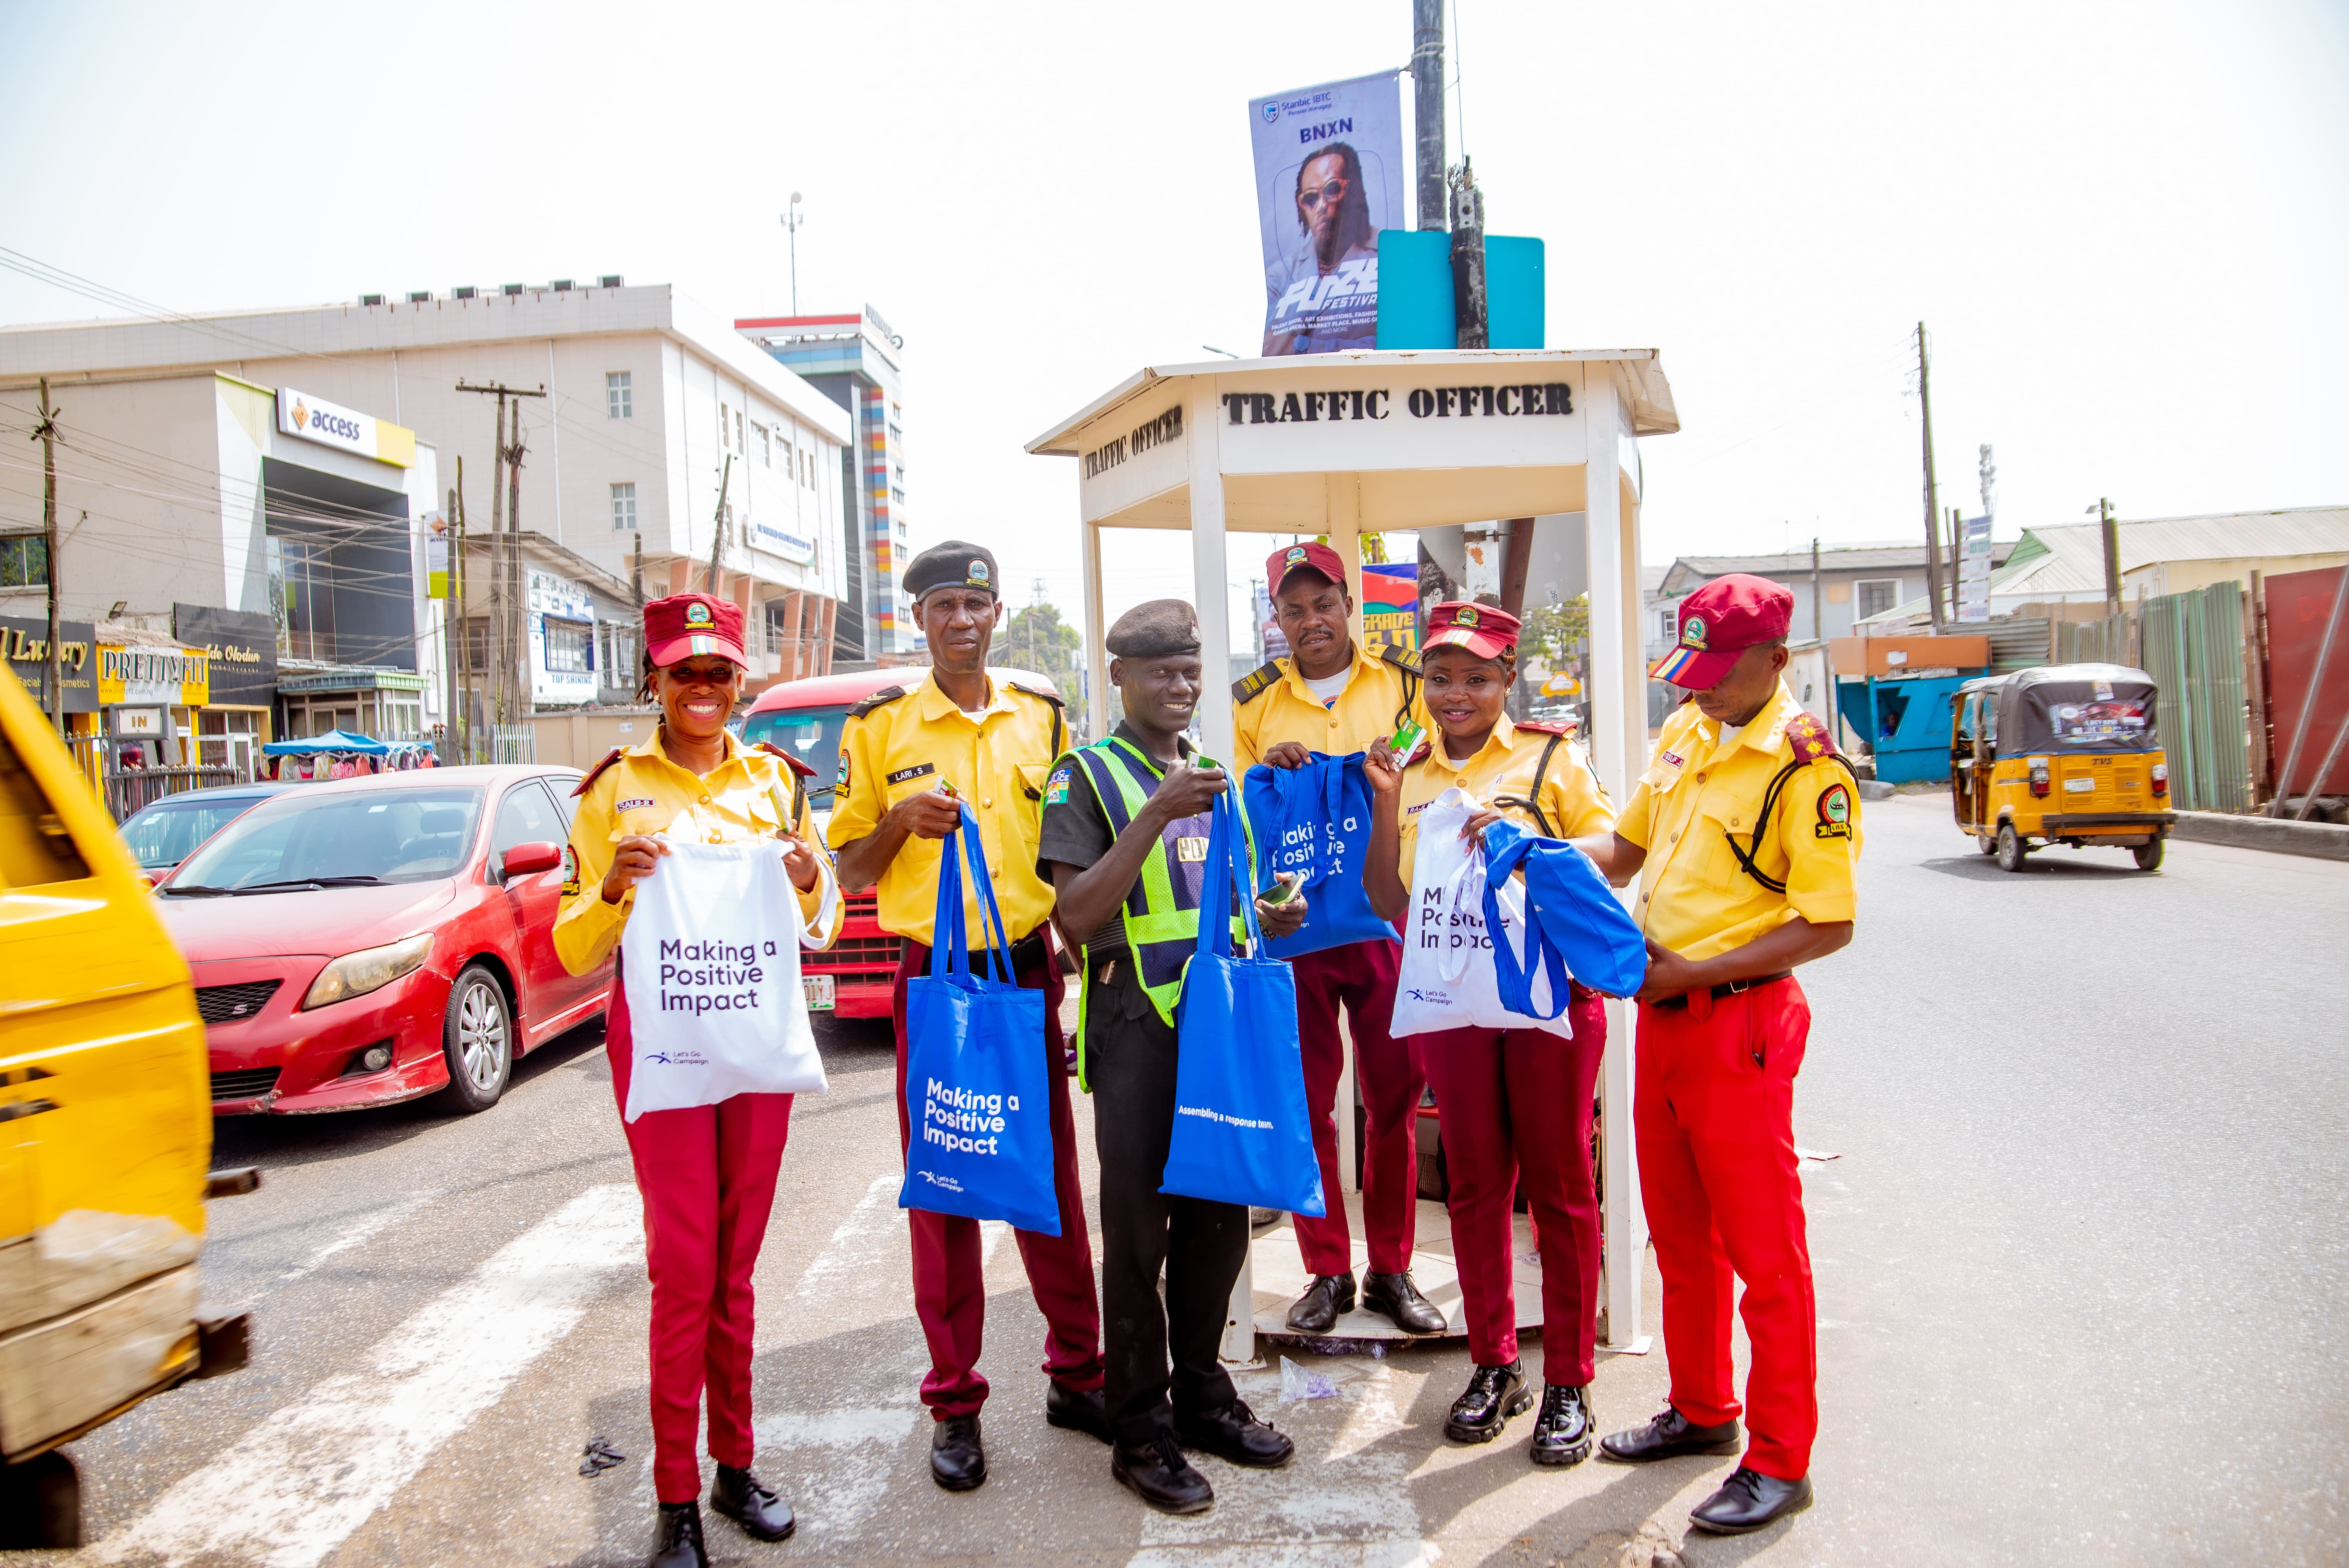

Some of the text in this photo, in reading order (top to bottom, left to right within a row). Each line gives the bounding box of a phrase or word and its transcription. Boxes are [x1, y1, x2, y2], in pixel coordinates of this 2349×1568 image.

[1282, 92, 1331, 110] Stanbic IBTC
[1309, 103, 1332, 111] Managers
[1300, 117, 1353, 143] BNXN
[1322, 294, 1378, 309] FESTIVA
[1271, 321, 1288, 330] TALENT
[1317, 312, 1354, 321] EXHIBITIONS,
[1273, 328, 1289, 336] GAMES
[1223, 383, 1574, 425] TRAFFIC OFFICER
[312, 409, 360, 441] access
[1085, 404, 1183, 480] TRAFFIC OFFICER
[102, 649, 206, 684] PRETTYFIT
[50, 678, 90, 688] smetics
[551, 674, 592, 684] TOP SHINING
[132, 716, 147, 727] IN
[1282, 816, 1358, 847] akig a
[661, 939, 777, 966] Making a
[1421, 930, 1493, 953] Impac
[661, 963, 764, 985] Positive
[661, 988, 759, 1016] Impact
[1426, 996, 1453, 1005] Campaign
[927, 1077, 1019, 1115] Making a
[925, 1098, 1005, 1133] Positive
[1178, 1105, 1218, 1122] Assembling
[1225, 1114, 1256, 1127] response
[1258, 1119, 1274, 1129] team.
[923, 1120, 998, 1155] Impact
[937, 1174, 949, 1182] Let's
[937, 1180, 964, 1193] Campaign
